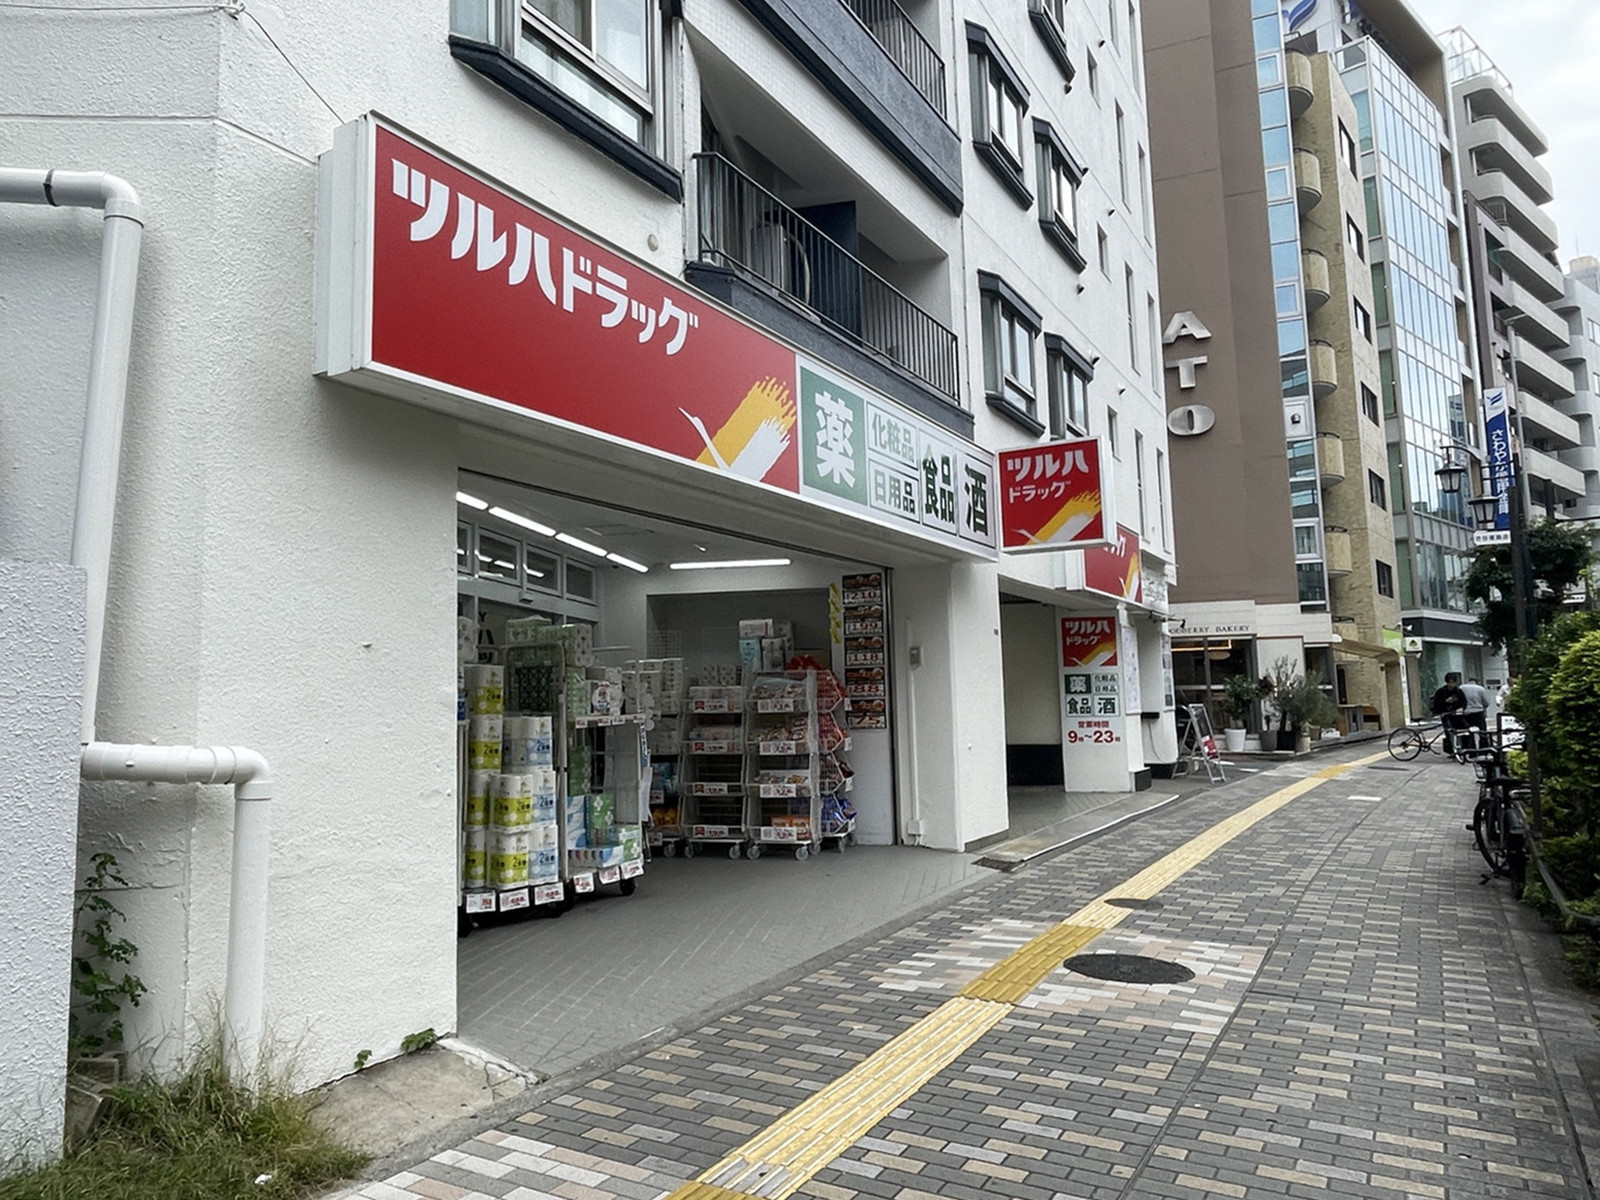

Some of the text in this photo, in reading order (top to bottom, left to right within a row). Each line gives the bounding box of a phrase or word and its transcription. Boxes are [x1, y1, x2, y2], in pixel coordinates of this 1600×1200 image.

[391, 157, 699, 356] ツルハドラッグ
[1162, 310, 1215, 436] ATO
[814, 390, 856, 488] 薬
[871, 412, 915, 462] 化粧品
[1006, 448, 1089, 483] ツルハ
[873, 469, 916, 515] 日用品
[921, 443, 956, 524] 食品
[963, 462, 988, 537] 酒
[1008, 479, 1071, 503] ドラッグ
[1065, 620, 1111, 635] ツルハ
[1065, 635, 1101, 646] ドラッグ
[1215, 624, 1250, 632] BAKERY
[1070, 675, 1087, 692] 薬
[1067, 697, 1092, 715] 食品
[1097, 697, 1116, 714] 酒
